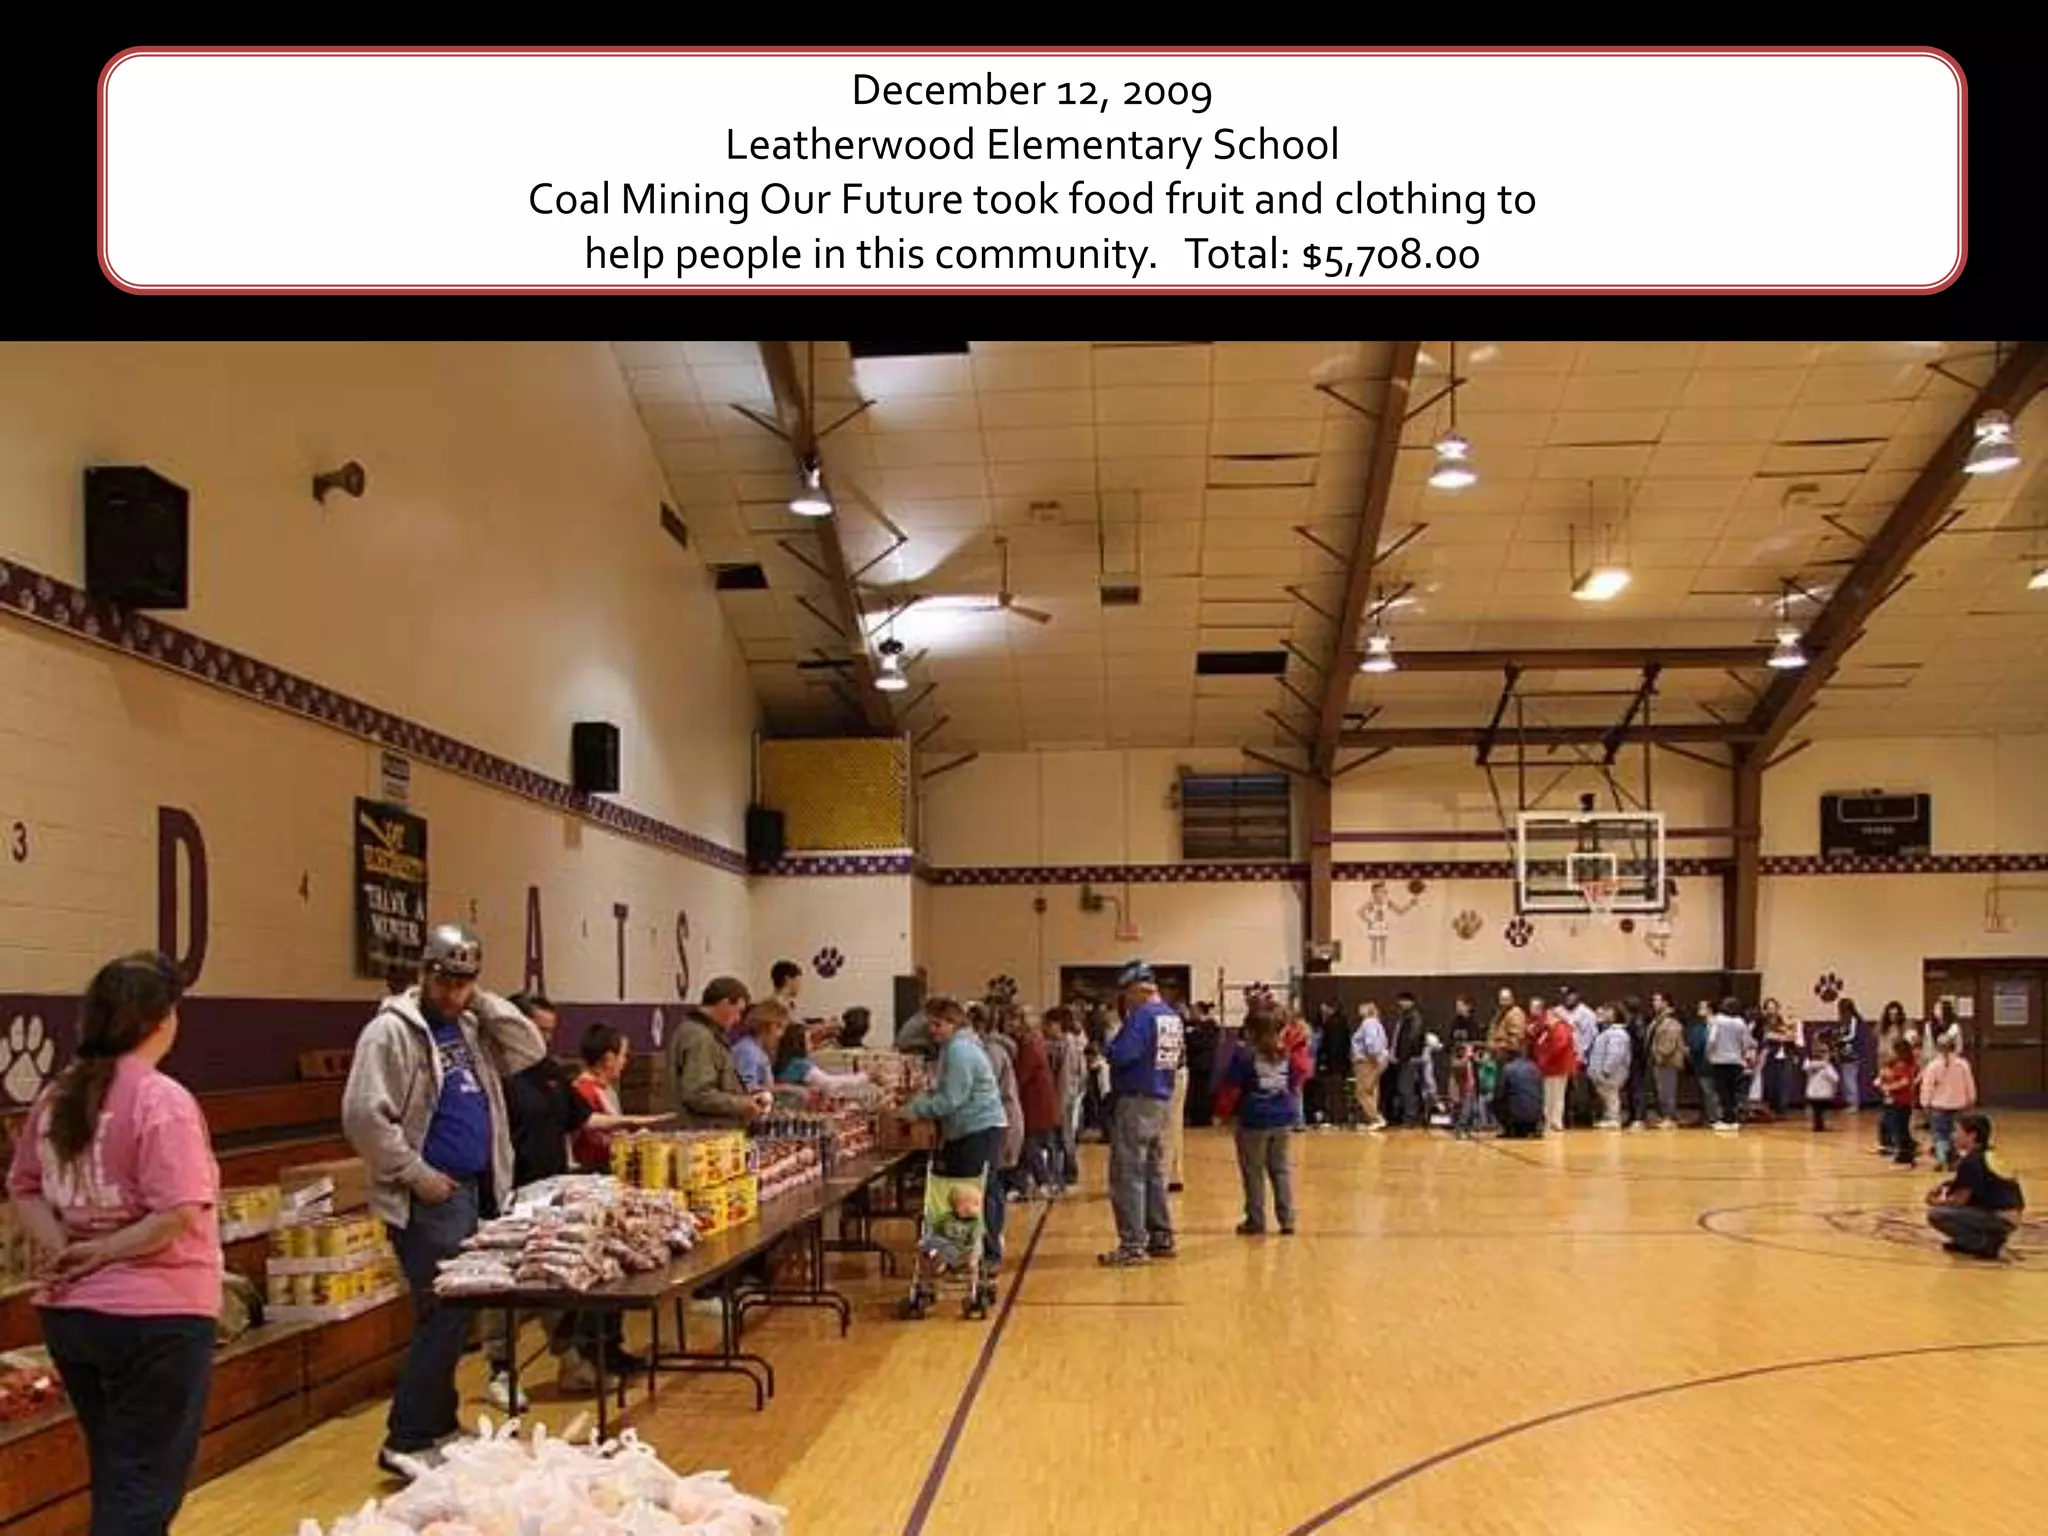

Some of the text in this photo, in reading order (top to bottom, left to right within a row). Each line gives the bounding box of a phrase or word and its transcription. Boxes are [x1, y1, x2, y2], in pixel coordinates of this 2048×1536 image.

[13, 821, 28, 862] 3
[158, 805, 690, 1001] D A T S
